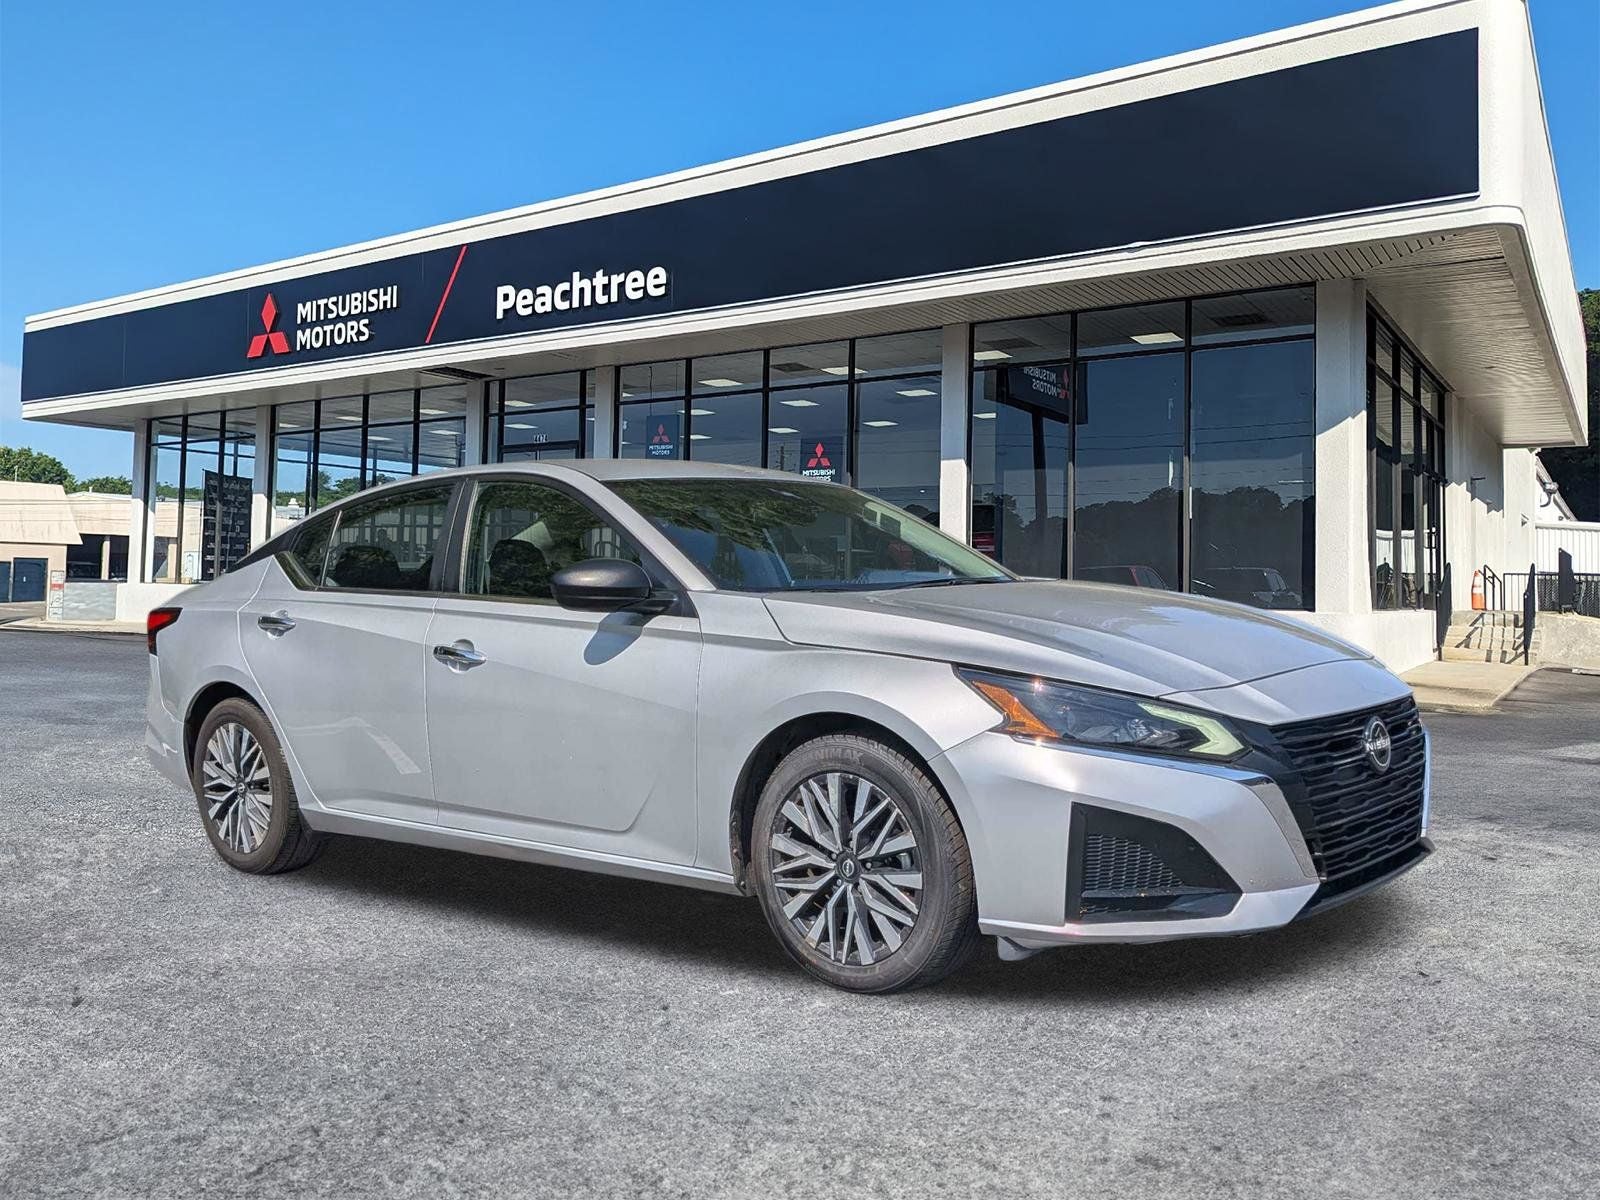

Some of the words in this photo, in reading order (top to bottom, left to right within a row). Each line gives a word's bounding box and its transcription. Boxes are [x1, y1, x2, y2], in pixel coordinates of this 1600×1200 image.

[296, 285, 398, 325] MITSUBISHI
[496, 266, 667, 320] Peachtree
[296, 318, 370, 351] MOTORS
[802, 468, 836, 477] MITSUBISHI
